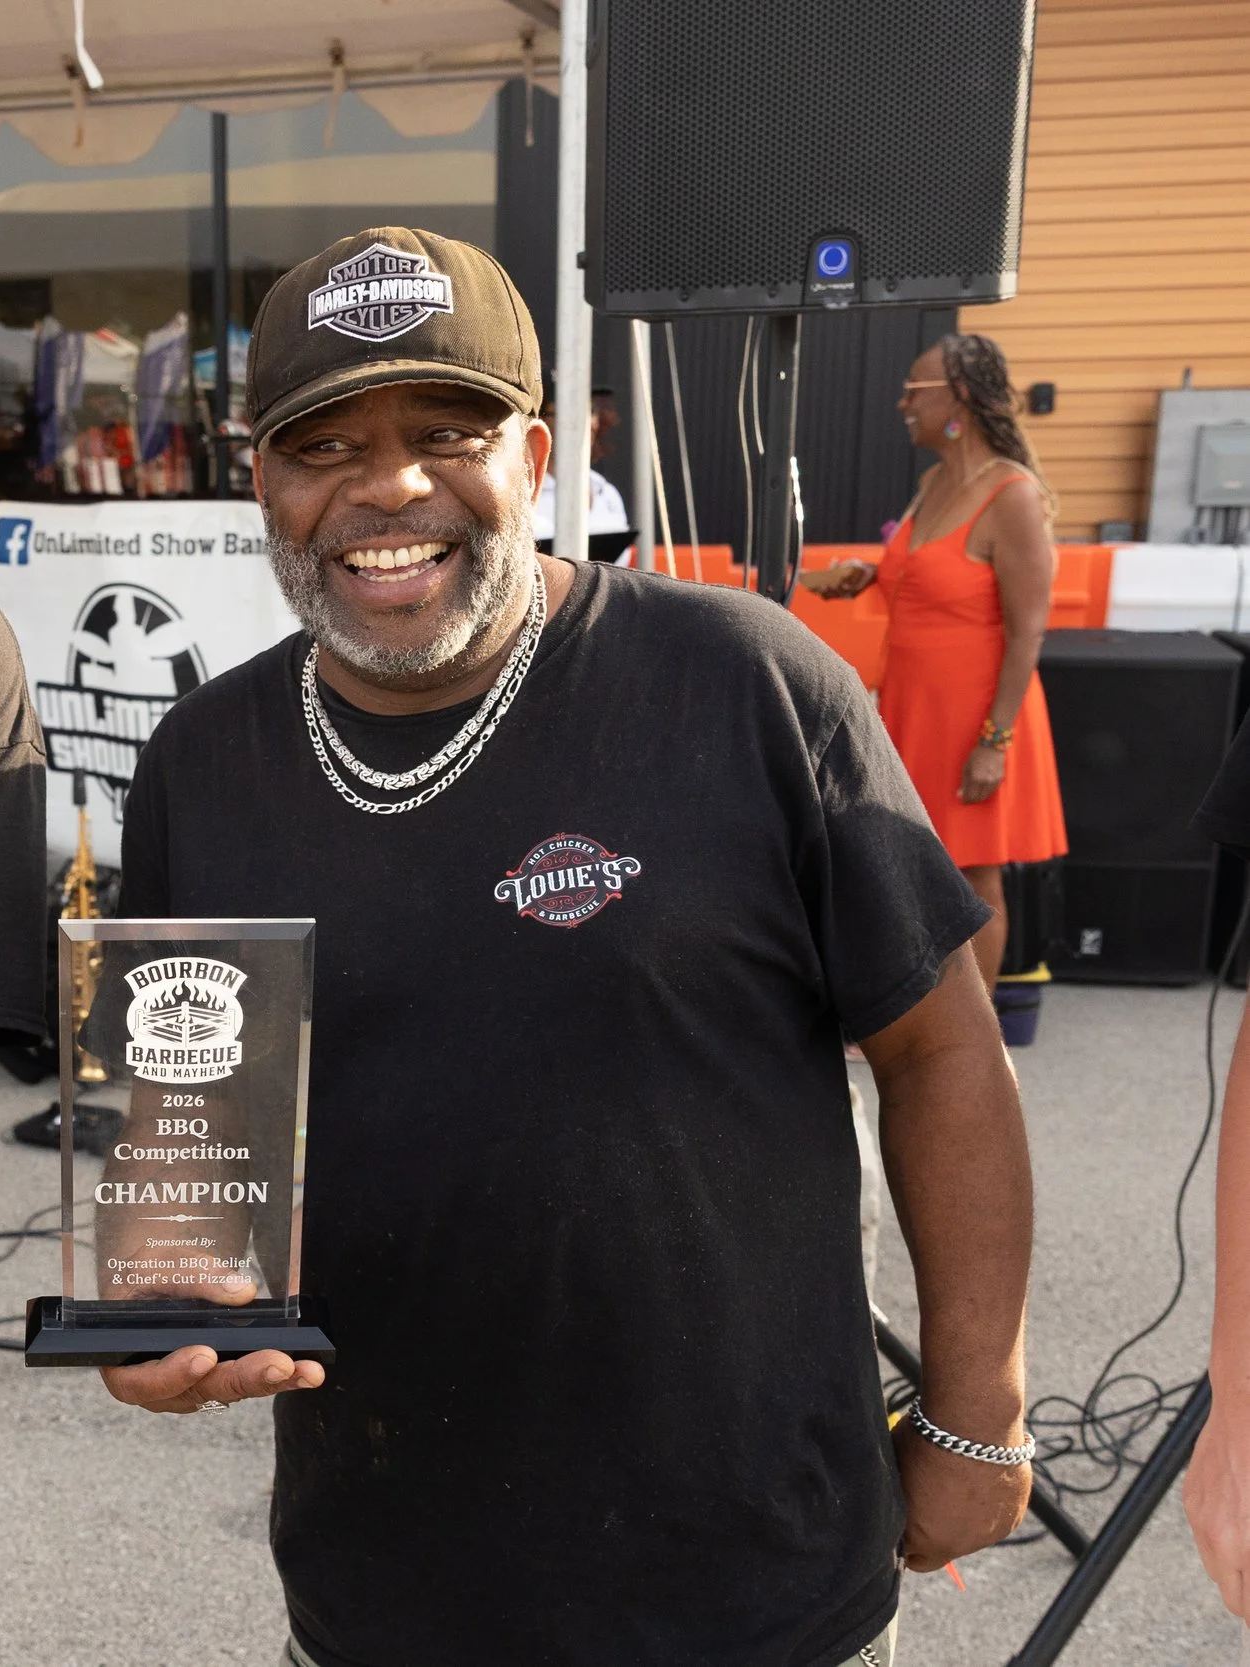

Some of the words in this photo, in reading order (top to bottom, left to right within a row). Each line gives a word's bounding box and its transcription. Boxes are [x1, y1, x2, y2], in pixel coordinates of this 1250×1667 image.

[342, 253, 414, 280] MOTOR
[315, 278, 445, 316] HARLEY-DAVIDSON
[345, 304, 414, 330] CYCLES
[152, 532, 215, 556] Show
[224, 532, 268, 555] Ban
[528, 848, 546, 866] HOT
[549, 840, 596, 854] CHICKEN
[494, 857, 641, 911] LOUIE'S
[538, 910, 546, 918] &
[548, 900, 601, 921] BARBECUE
[131, 961, 241, 990] BOURBON
[131, 1045, 238, 1066] BARBECUE
[142, 1066, 167, 1078] AND
[173, 1065, 226, 1078] MAYHEM
[162, 1094, 205, 1108] 2026
[156, 1118, 210, 1139] BBQ
[114, 1143, 250, 1165] Competition
[94, 1181, 269, 1205] CHAMPION
[145, 1237, 198, 1248] Sponsored
[200, 1237, 217, 1248] By:
[107, 1257, 175, 1271] Operation
[179, 1257, 210, 1271] BBQ
[212, 1256, 253, 1269] Relief
[112, 1274, 123, 1285] &
[126, 1272, 169, 1285] Chef's
[172, 1273, 195, 1285] Cut
[199, 1272, 252, 1285] Pizzeria
